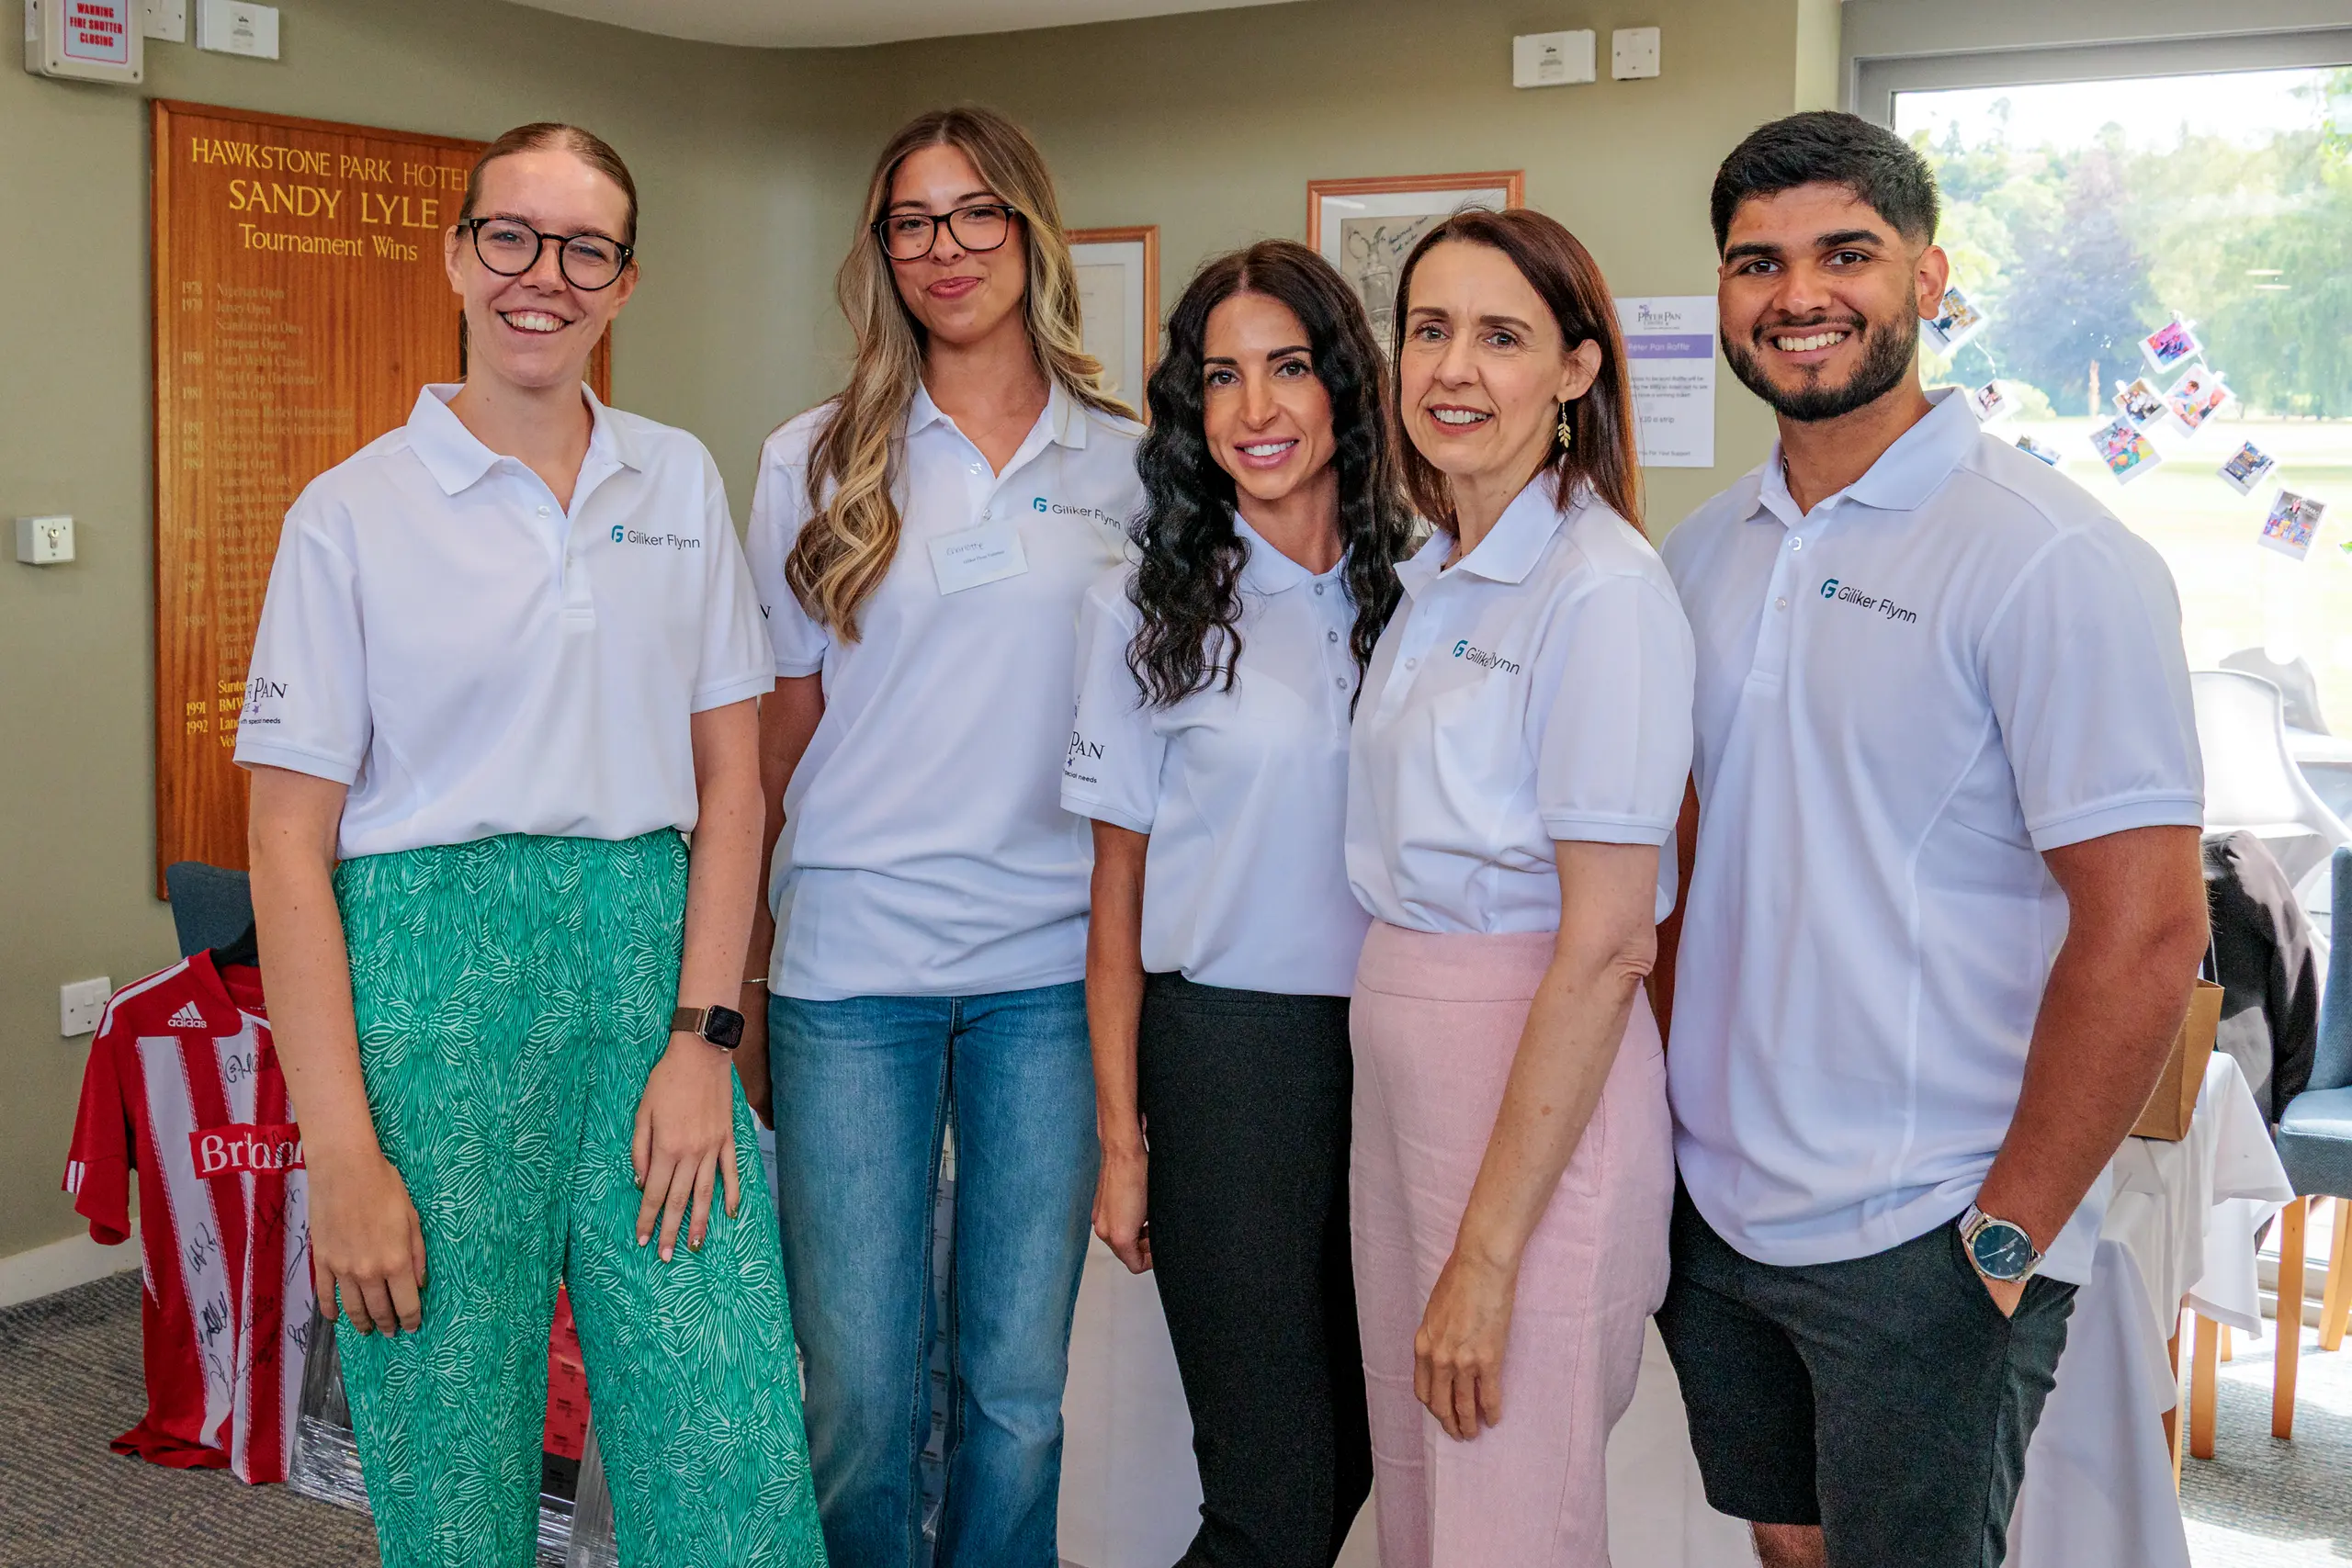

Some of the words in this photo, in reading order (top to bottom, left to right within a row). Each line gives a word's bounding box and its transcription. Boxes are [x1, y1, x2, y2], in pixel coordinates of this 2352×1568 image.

[77, 3, 114, 18] WARNING
[70, 17, 86, 28] FIRE
[88, 19, 123, 34] SHUTTER
[80, 32, 114, 48] CLOSING
[192, 138, 331, 177] HAWKSTONE
[340, 155, 392, 184] PARK
[229, 179, 342, 220] SANDY
[361, 192, 439, 230] LYLE
[239, 223, 363, 257] Tournament
[372, 235, 418, 262] Wins
[1052, 504, 1091, 517] Giliker
[1094, 509, 1121, 530] Flynn
[627, 530, 663, 546] Giliker
[667, 534, 700, 550] Flynn
[1838, 586, 1877, 609] Giliker
[1878, 598, 1917, 624] Flynn
[187, 702, 206, 716] 1991
[187, 719, 208, 735] 1992
[1068, 730, 1105, 761] PAN
[1078, 774, 1098, 784] needs
[167, 1018, 208, 1029] adidas
